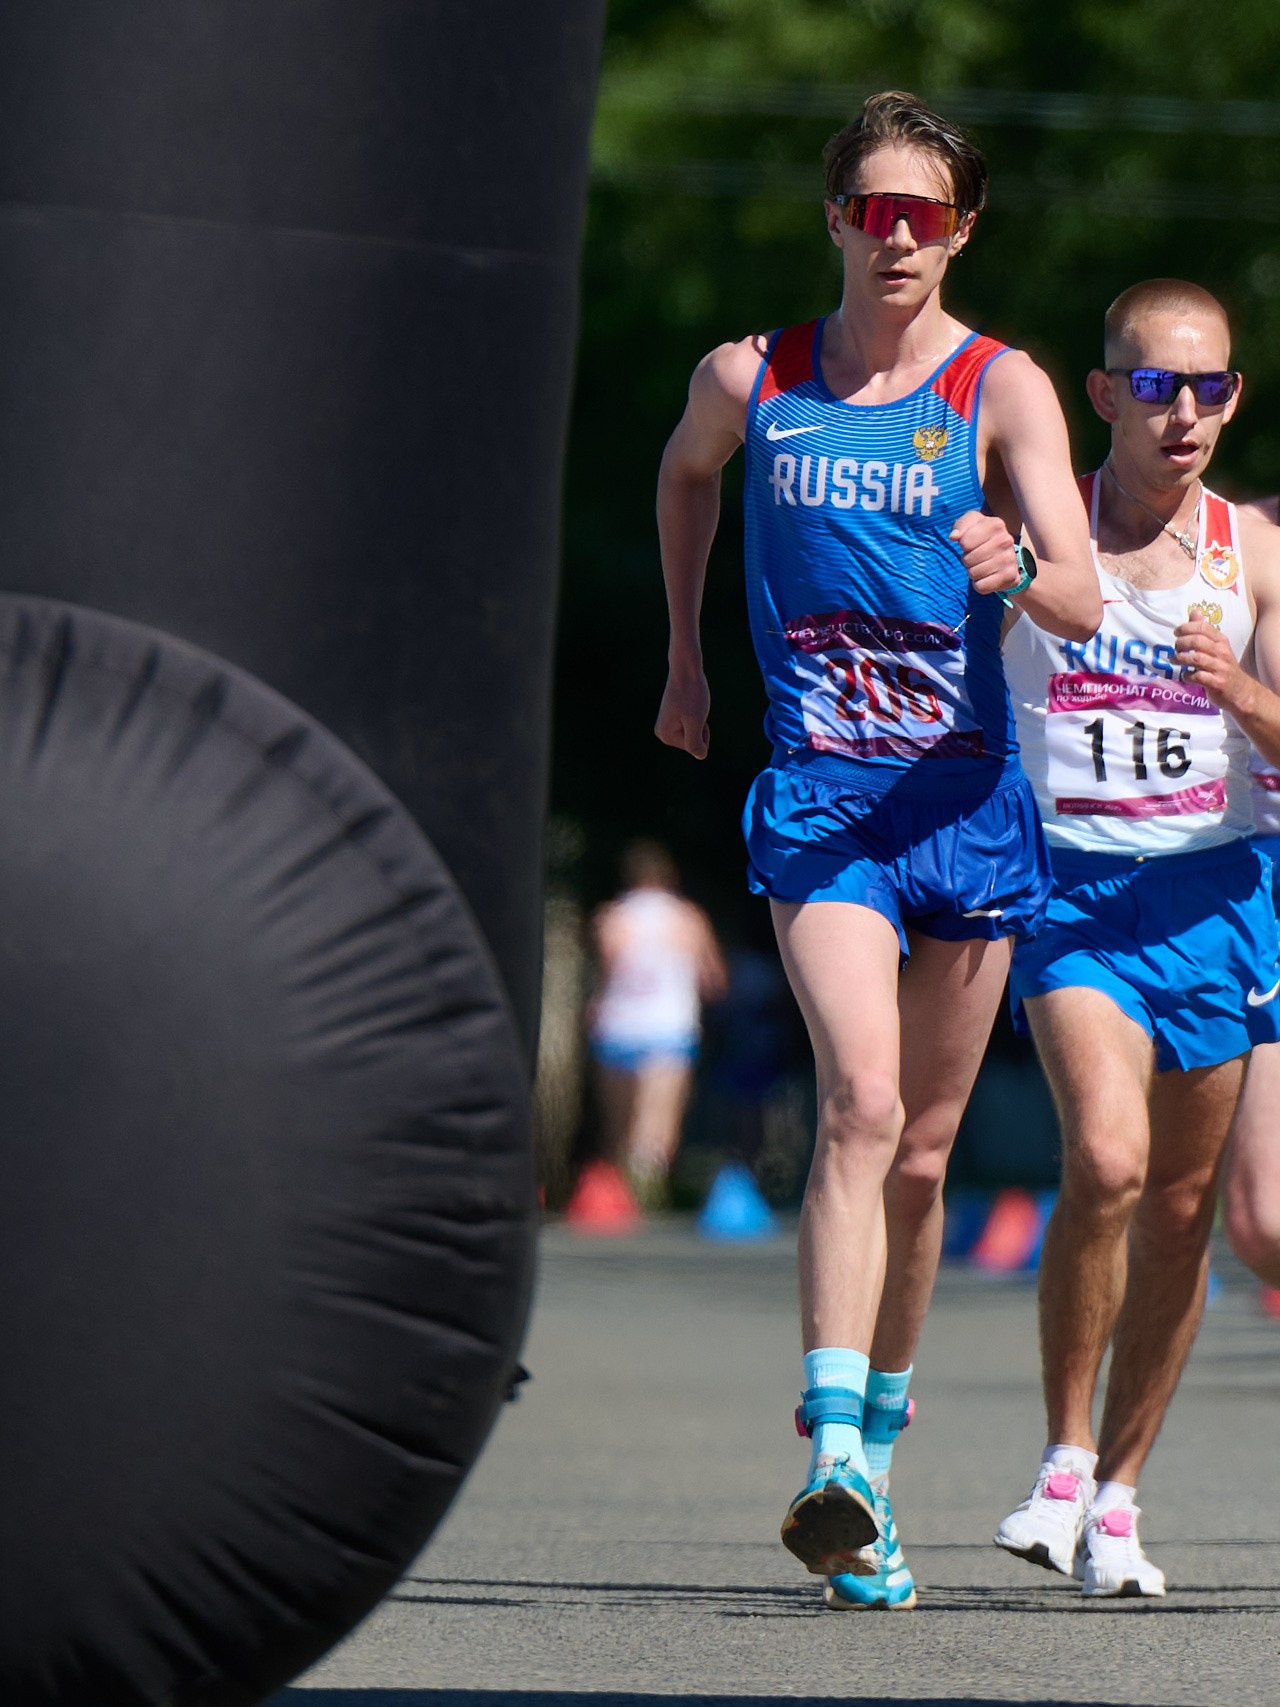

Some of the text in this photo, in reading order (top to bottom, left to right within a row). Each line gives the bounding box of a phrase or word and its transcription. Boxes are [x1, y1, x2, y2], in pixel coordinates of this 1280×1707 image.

[768, 453, 939, 517] RUSSIA
[1056, 682, 1211, 709] ЧЕМПИОНАТ РОССИИ
[1084, 717, 1192, 783] 116
